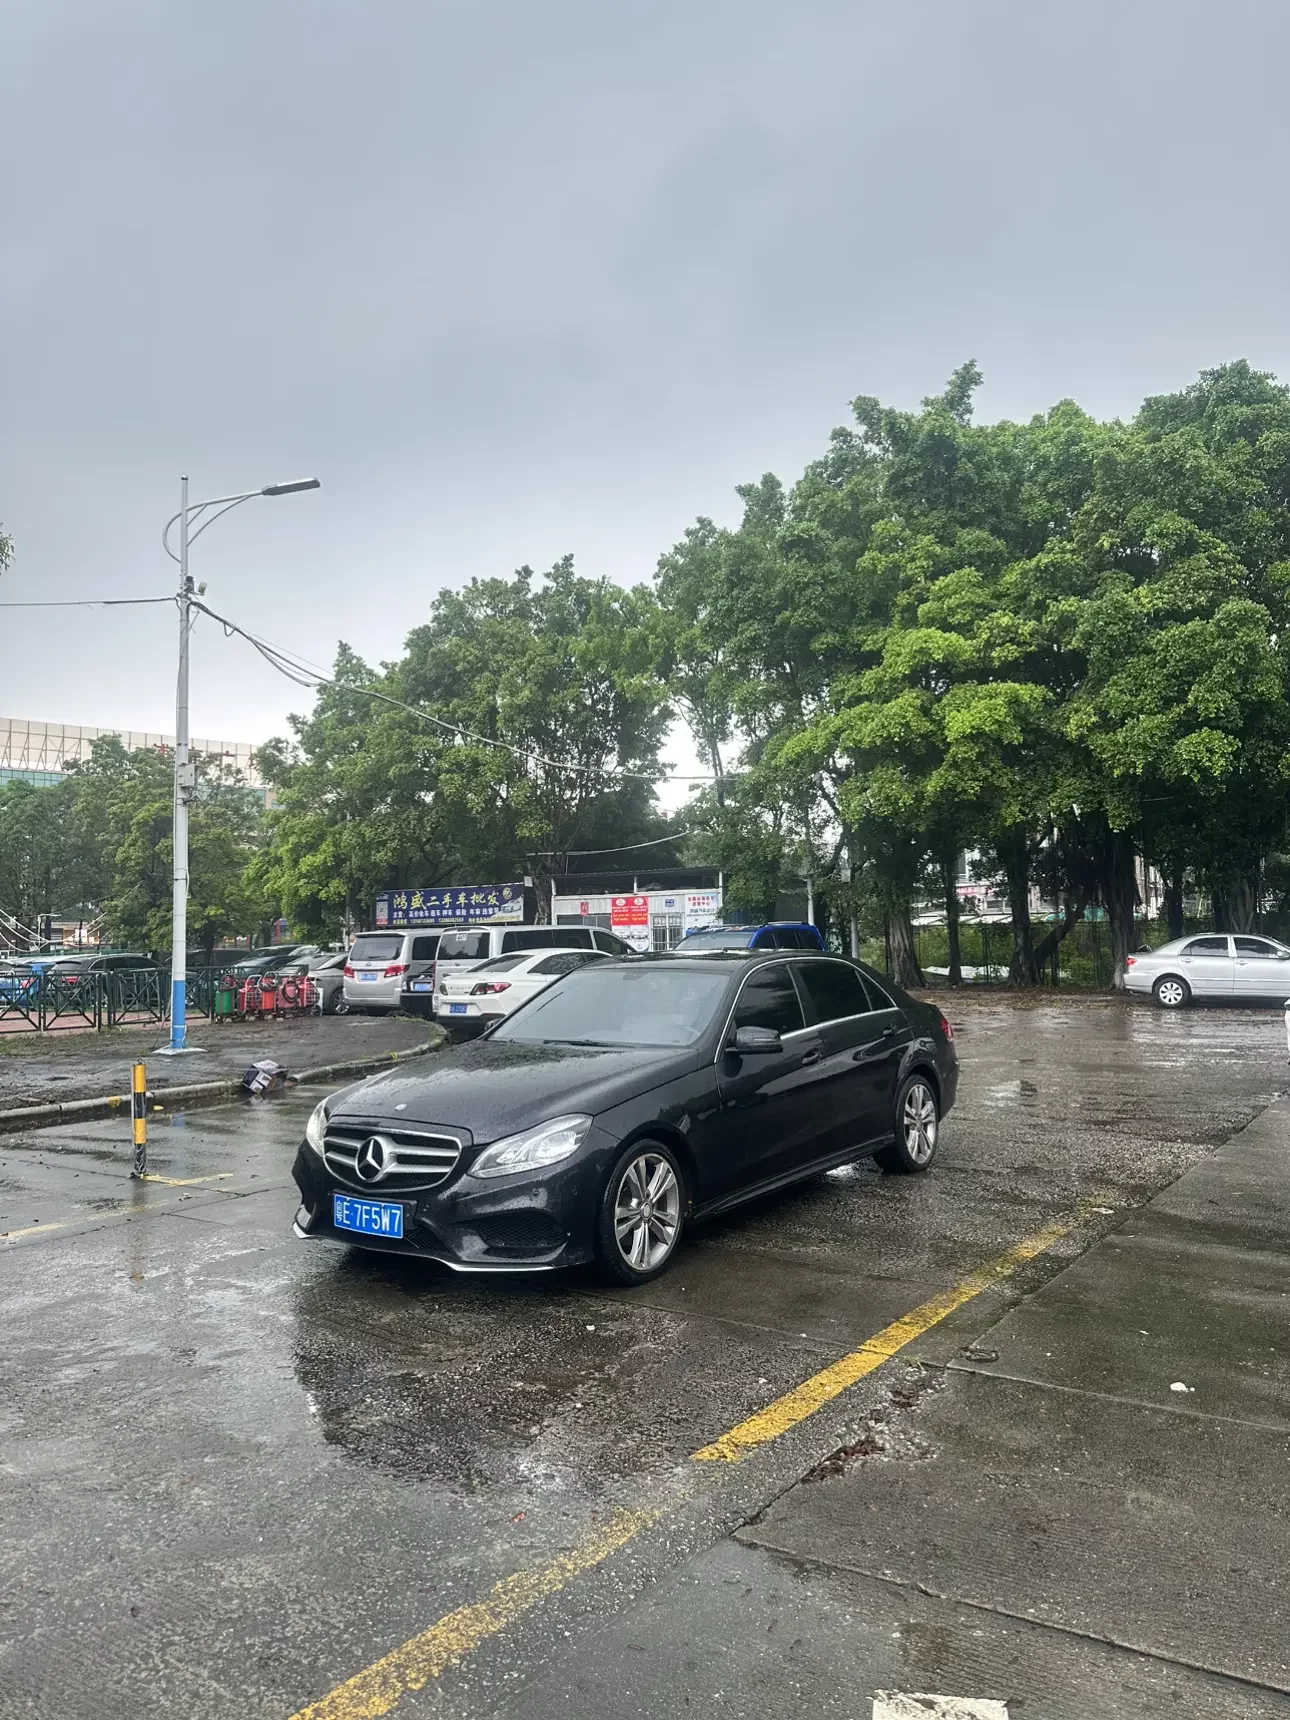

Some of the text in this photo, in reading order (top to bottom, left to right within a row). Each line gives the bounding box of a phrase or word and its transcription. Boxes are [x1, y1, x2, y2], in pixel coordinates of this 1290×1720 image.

[393, 890, 500, 909] 鸿盛二手车批发
